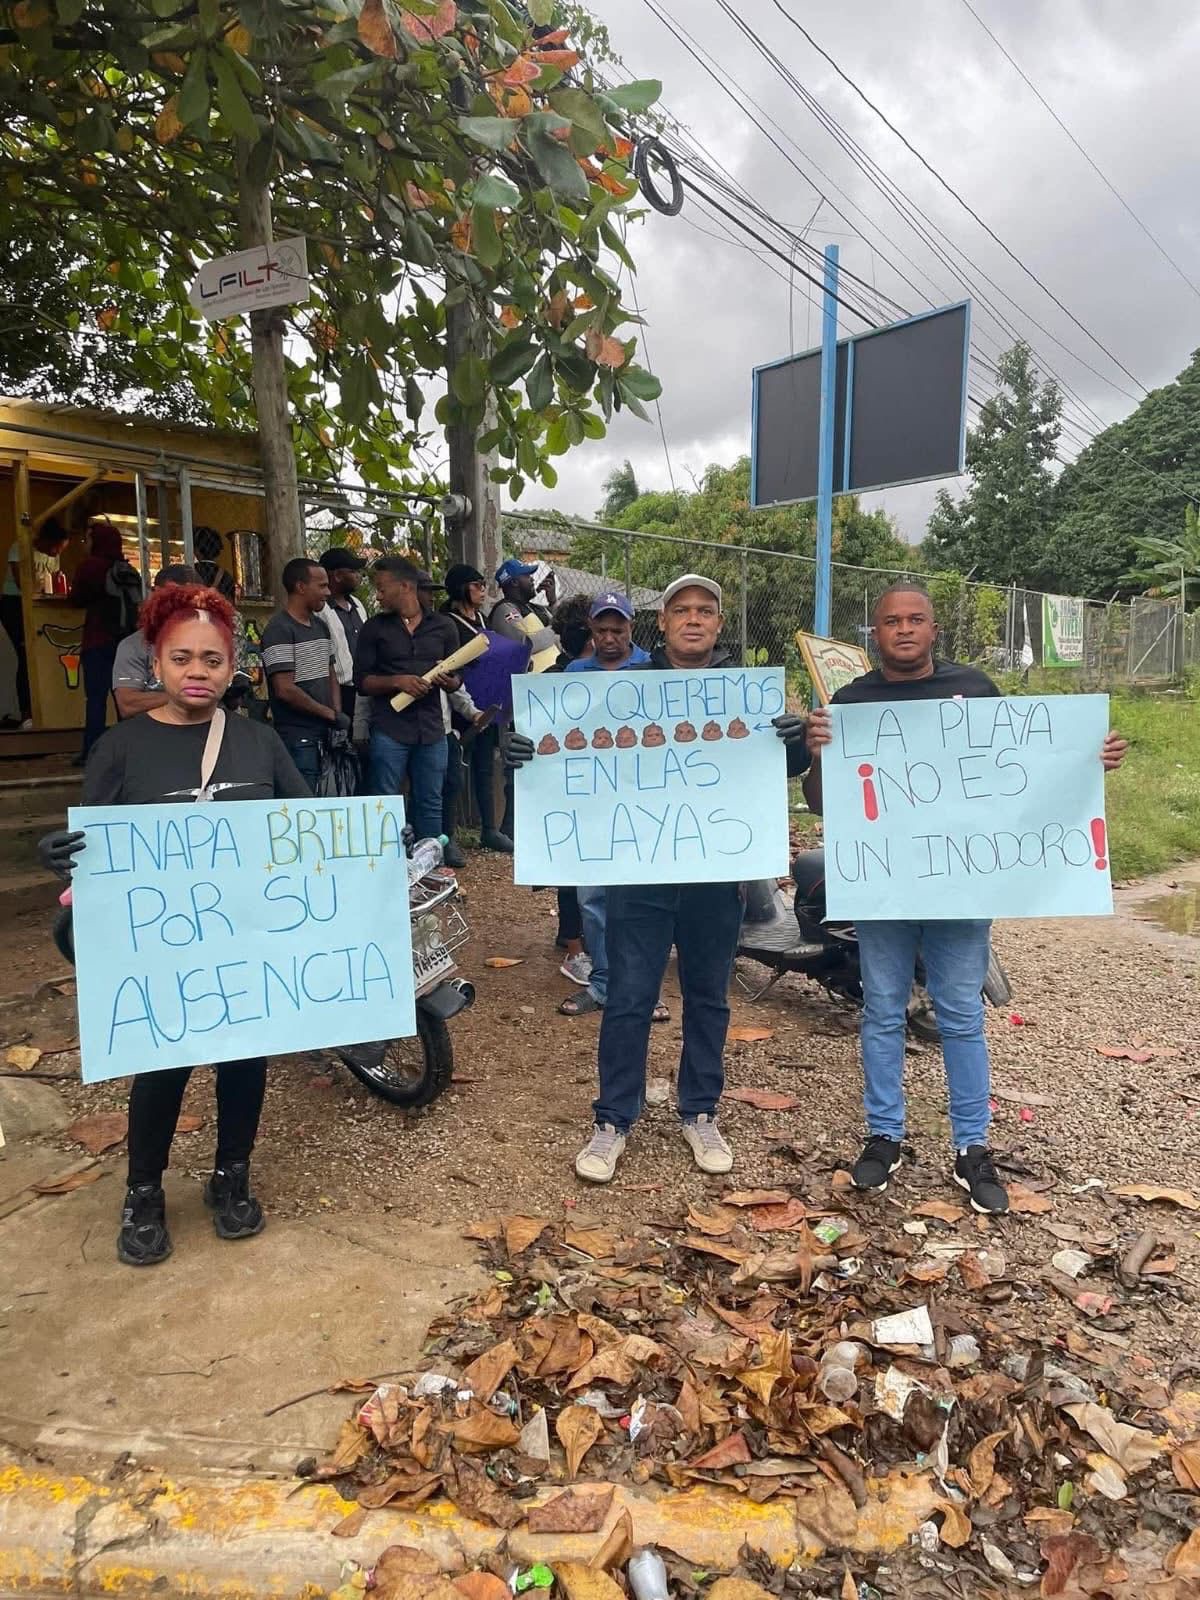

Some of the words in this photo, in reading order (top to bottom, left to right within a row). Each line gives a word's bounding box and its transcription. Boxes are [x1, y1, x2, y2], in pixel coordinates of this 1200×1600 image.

[527, 681, 591, 727] NO
[606, 674, 783, 721] QUEREMOS
[840, 708, 907, 759] LA
[939, 700, 1052, 748] PLAYA
[565, 756, 618, 800] EN
[637, 748, 721, 791] LAS
[958, 748, 1027, 799] ES
[83, 814, 240, 875] INAPA
[266, 803, 400, 865] BRILLA
[544, 803, 753, 864] PLAYAS
[835, 837, 891, 882] UN
[263, 874, 337, 932] SU
[108, 942, 394, 1055] AUSENCIA
